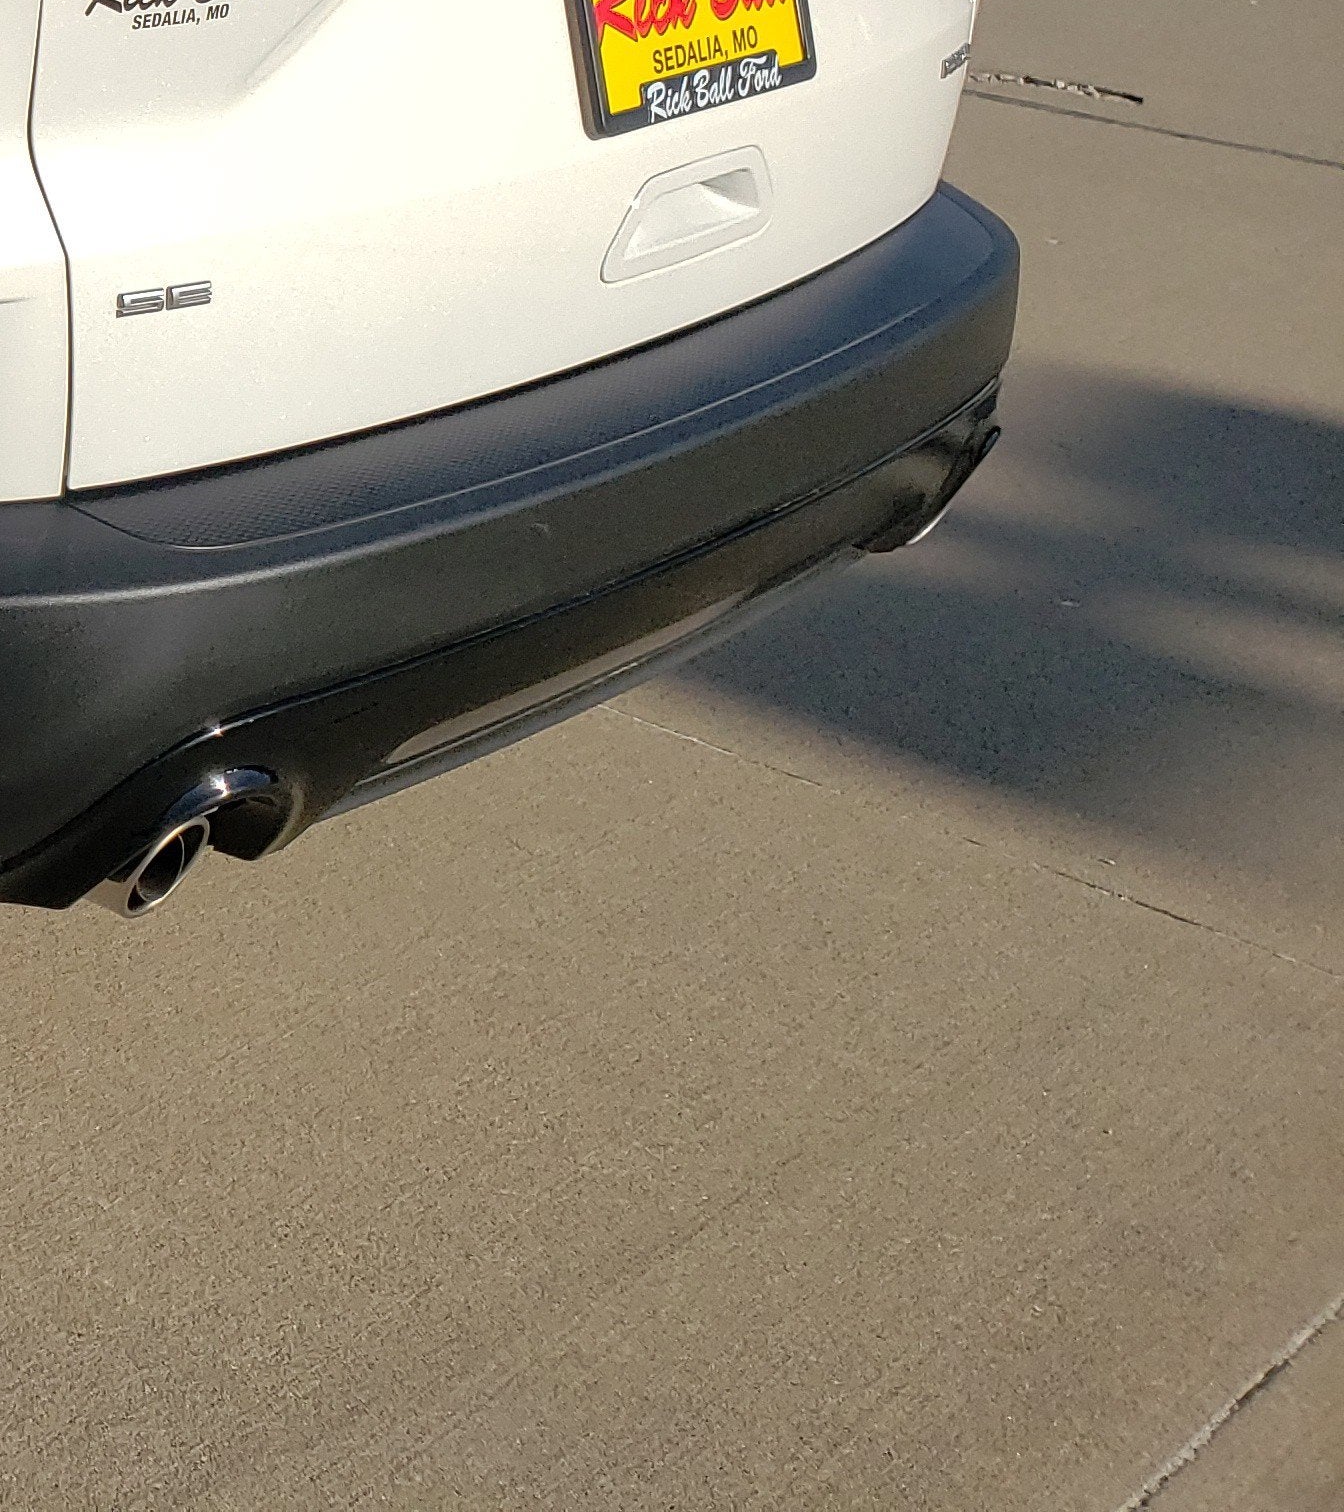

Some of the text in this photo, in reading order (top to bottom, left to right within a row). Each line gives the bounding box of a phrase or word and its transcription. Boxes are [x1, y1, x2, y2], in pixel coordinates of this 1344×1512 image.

[131, 3, 230, 30] SEDALIA, MO
[652, 25, 758, 75] SEDALIA, MO
[646, 54, 783, 124] Rick Ball Ford
[115, 279, 213, 319] SE
